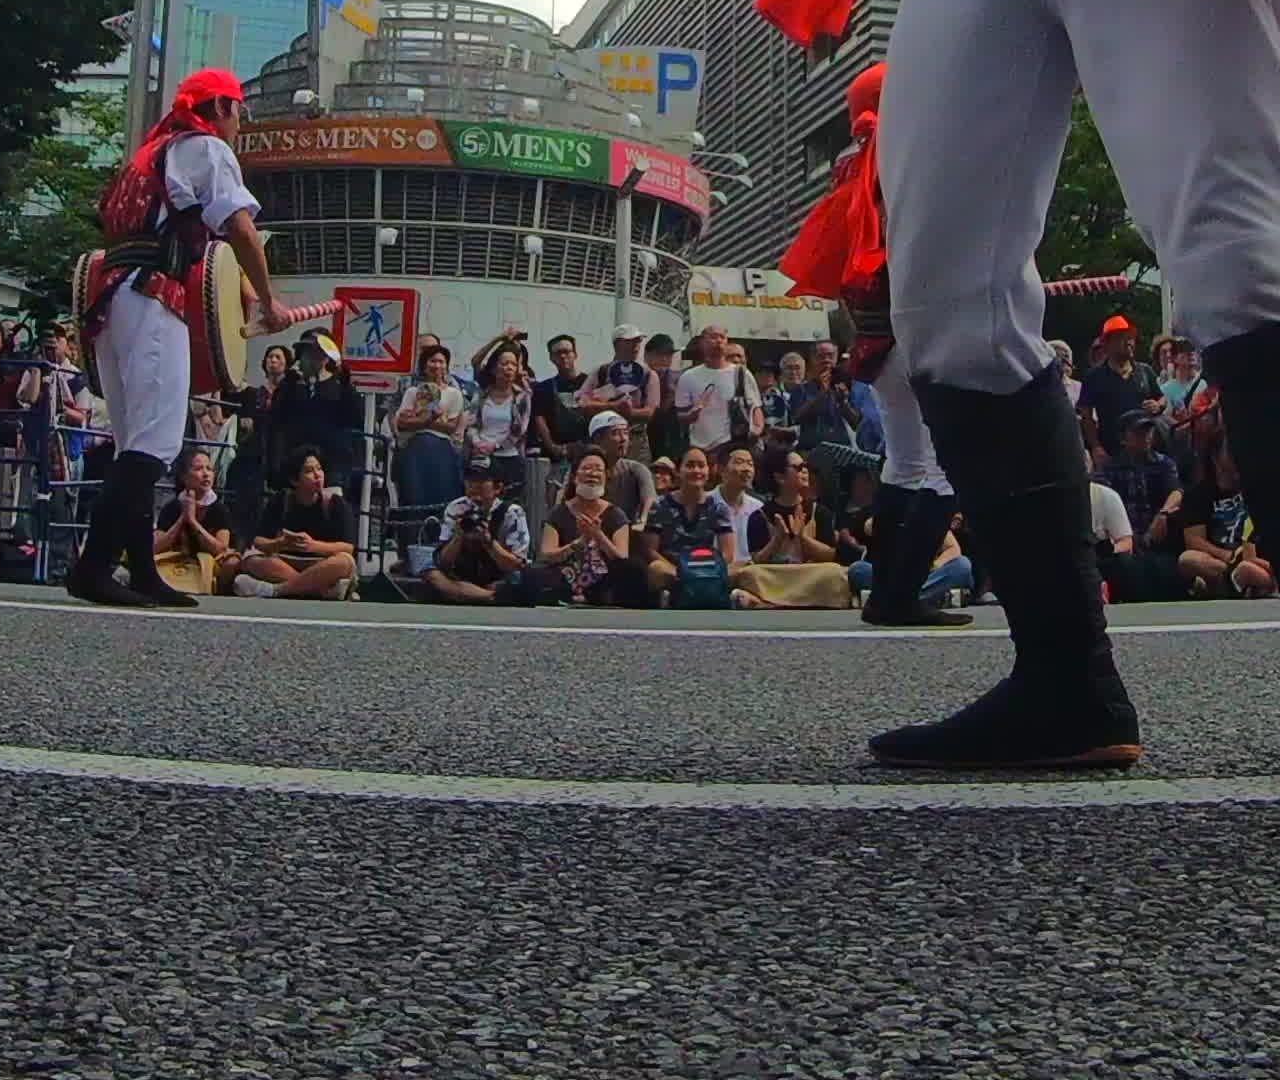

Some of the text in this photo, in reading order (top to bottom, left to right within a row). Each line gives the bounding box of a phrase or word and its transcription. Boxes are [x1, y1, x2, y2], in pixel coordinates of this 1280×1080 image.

[657, 51, 698, 115] P
[492, 130, 593, 168] MEN'S
[742, 267, 767, 296] P
